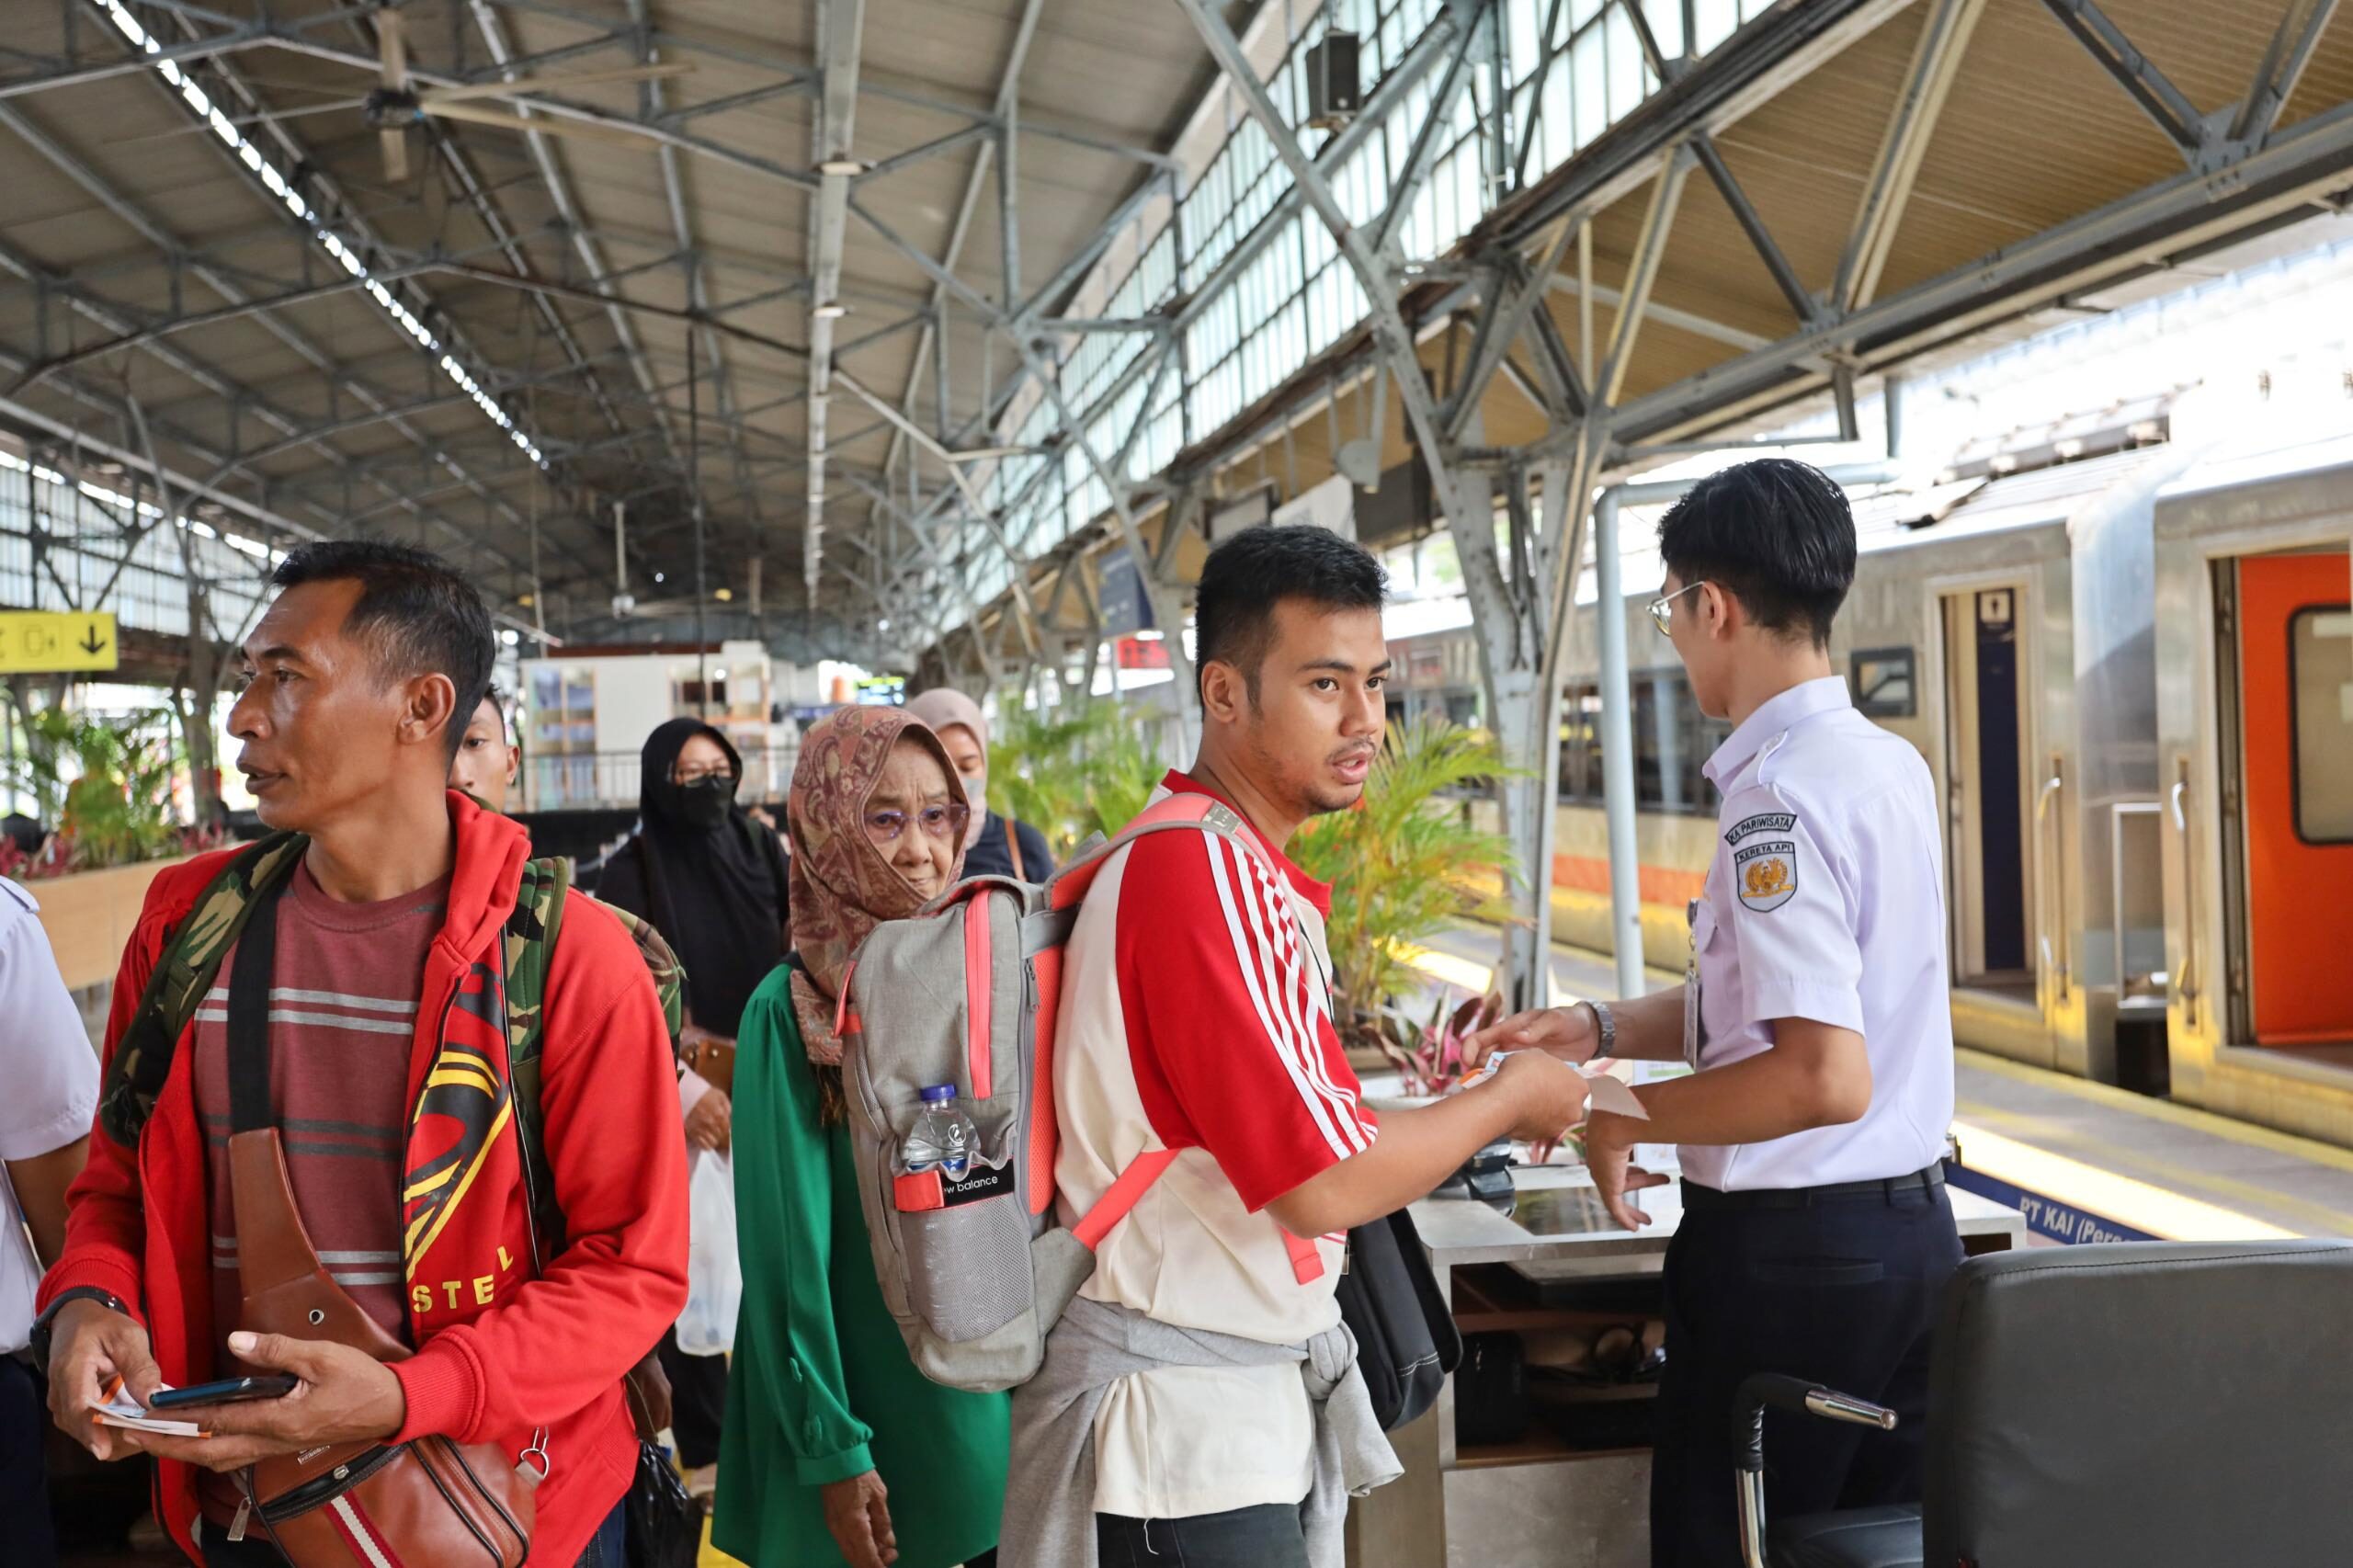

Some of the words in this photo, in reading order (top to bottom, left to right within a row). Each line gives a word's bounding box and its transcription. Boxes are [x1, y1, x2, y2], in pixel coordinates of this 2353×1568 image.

[1728, 829, 1741, 841] KA
[1741, 816, 1790, 834] PARIWISATA
[1738, 845, 1772, 861] KERETA
[1774, 844, 1790, 852] API
[957, 1176, 998, 1192] balance
[2019, 1197, 2041, 1223] PT
[2043, 1205, 2075, 1235] KAI
